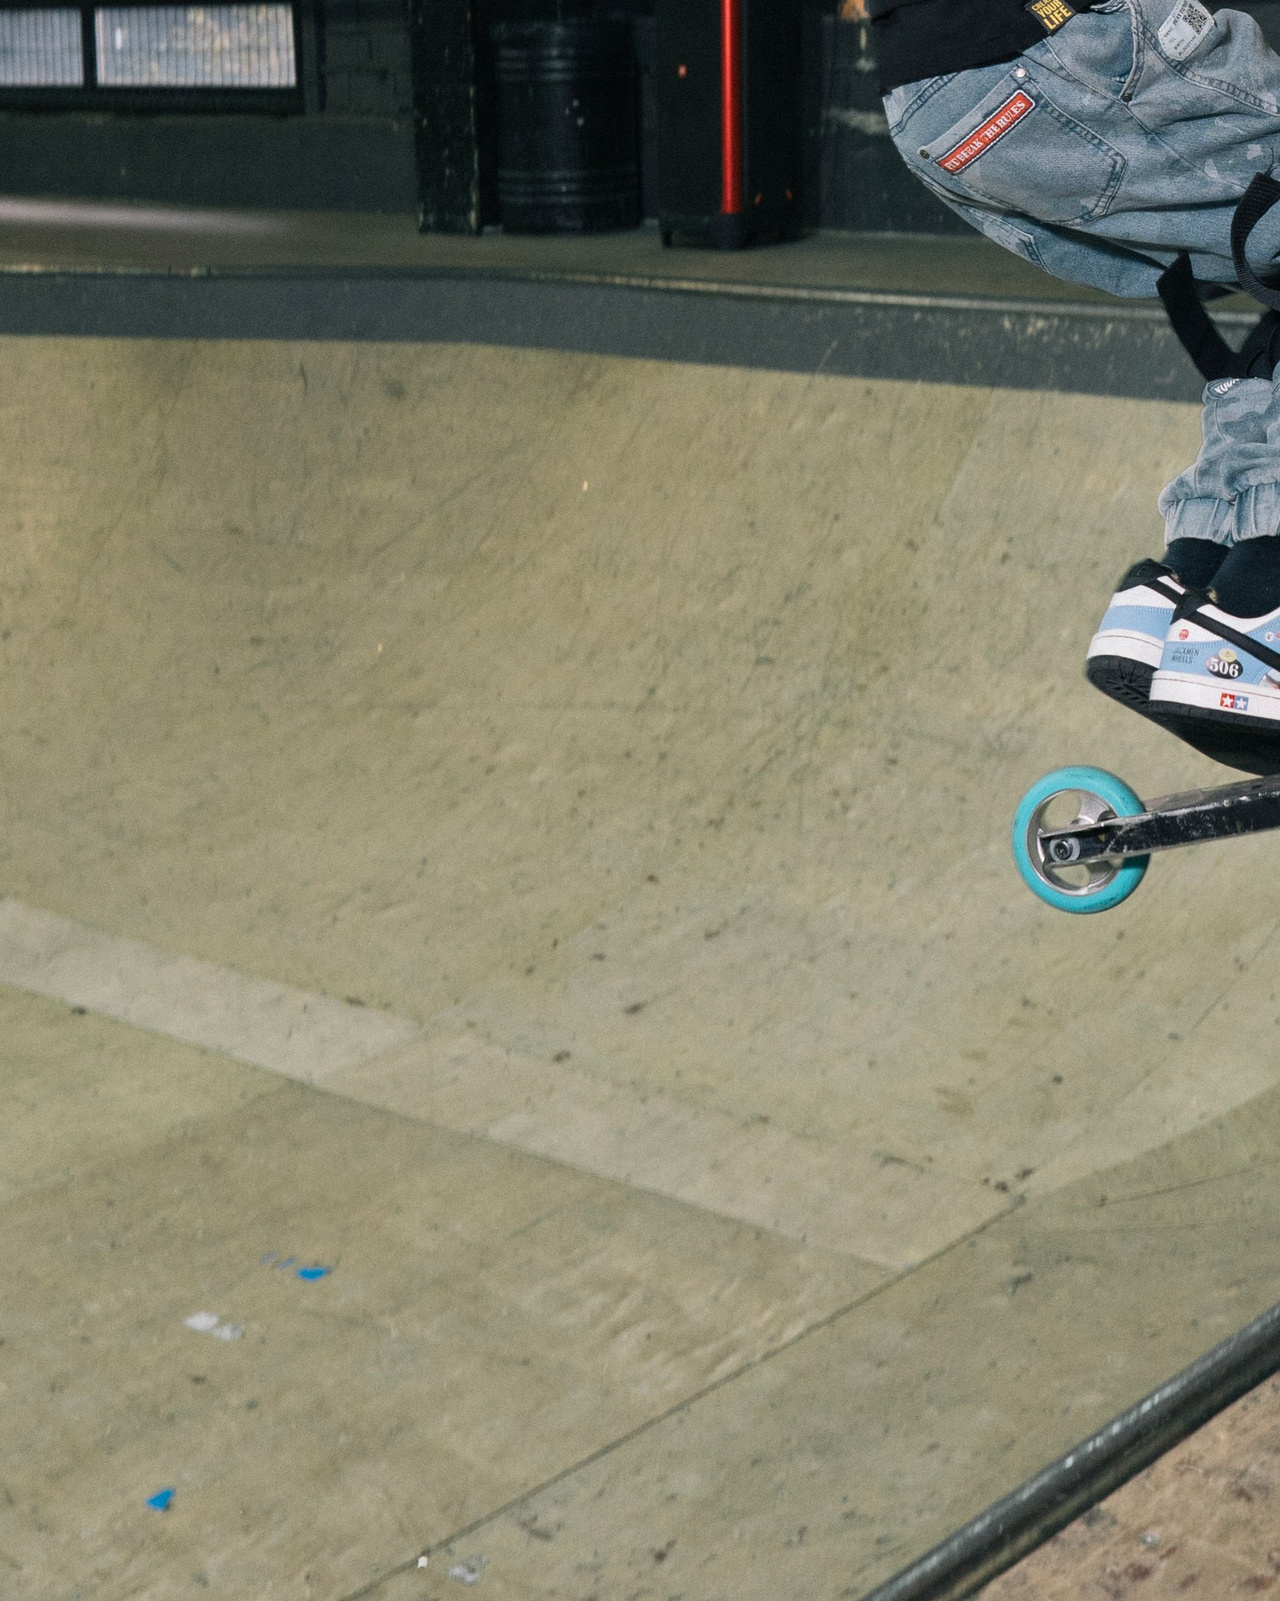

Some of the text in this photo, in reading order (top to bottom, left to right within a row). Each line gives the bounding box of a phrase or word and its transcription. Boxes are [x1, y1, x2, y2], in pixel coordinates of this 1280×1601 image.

[1037, 0, 1062, 18] YOUR
[1043, 5, 1072, 29] LIFE
[957, 138, 983, 162] BREAK
[980, 124, 1000, 141] THE
[996, 100, 1026, 128] RULES
[1209, 657, 1240, 678] 506
